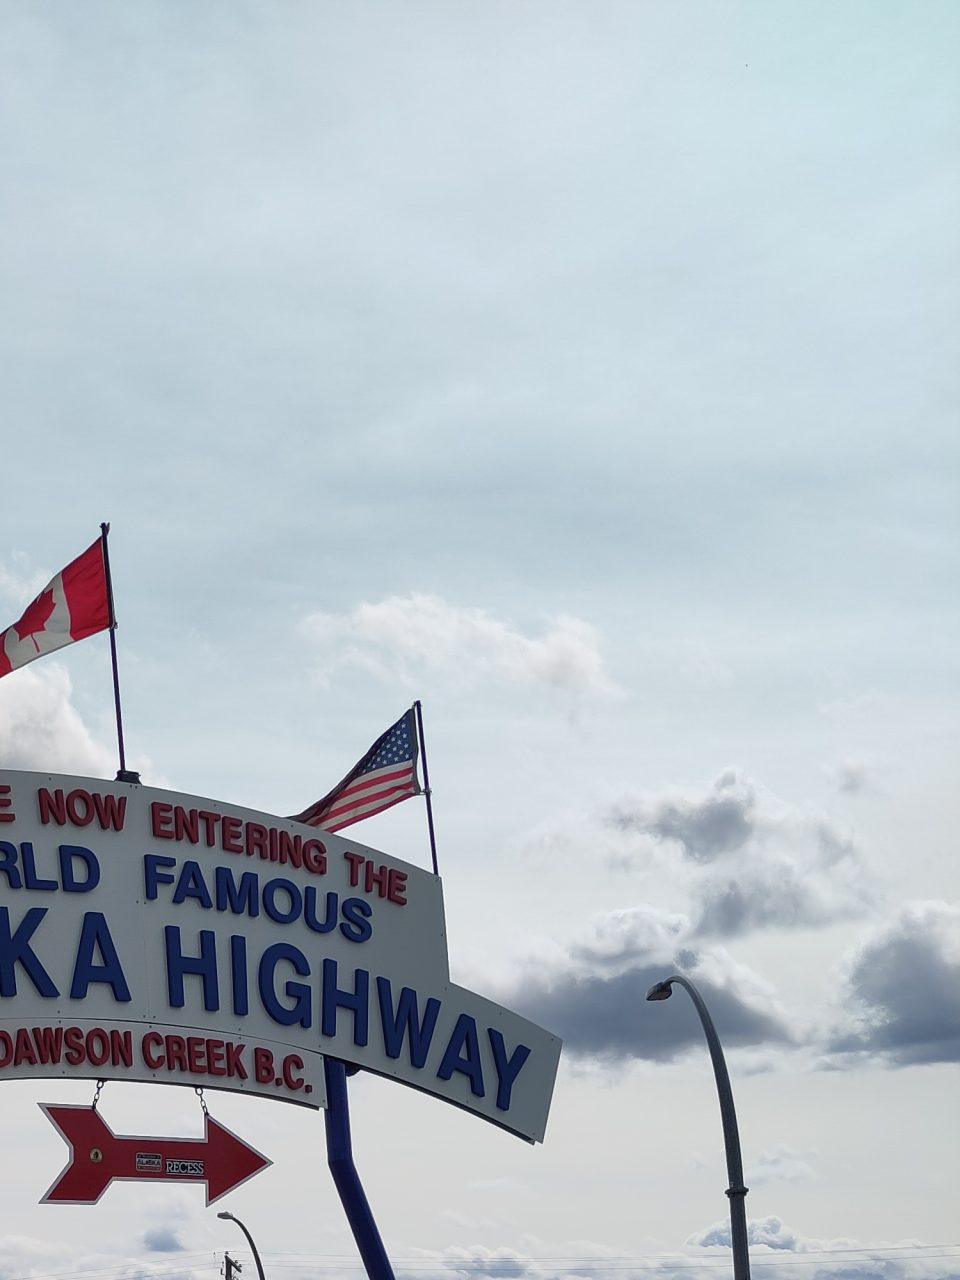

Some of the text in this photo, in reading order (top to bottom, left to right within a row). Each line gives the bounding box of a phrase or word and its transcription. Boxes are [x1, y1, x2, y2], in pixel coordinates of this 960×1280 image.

[38, 787, 127, 831] NOW
[151, 801, 327, 876] ENTERING
[344, 851, 408, 905] THE
[143, 853, 372, 943] FAMOUS
[142, 1031, 248, 1080] CREEK
[255, 1046, 313, 1093] B.C.
[164, 925, 531, 1112] HIGHWAY
[166, 1161, 204, 1174] RECESS
